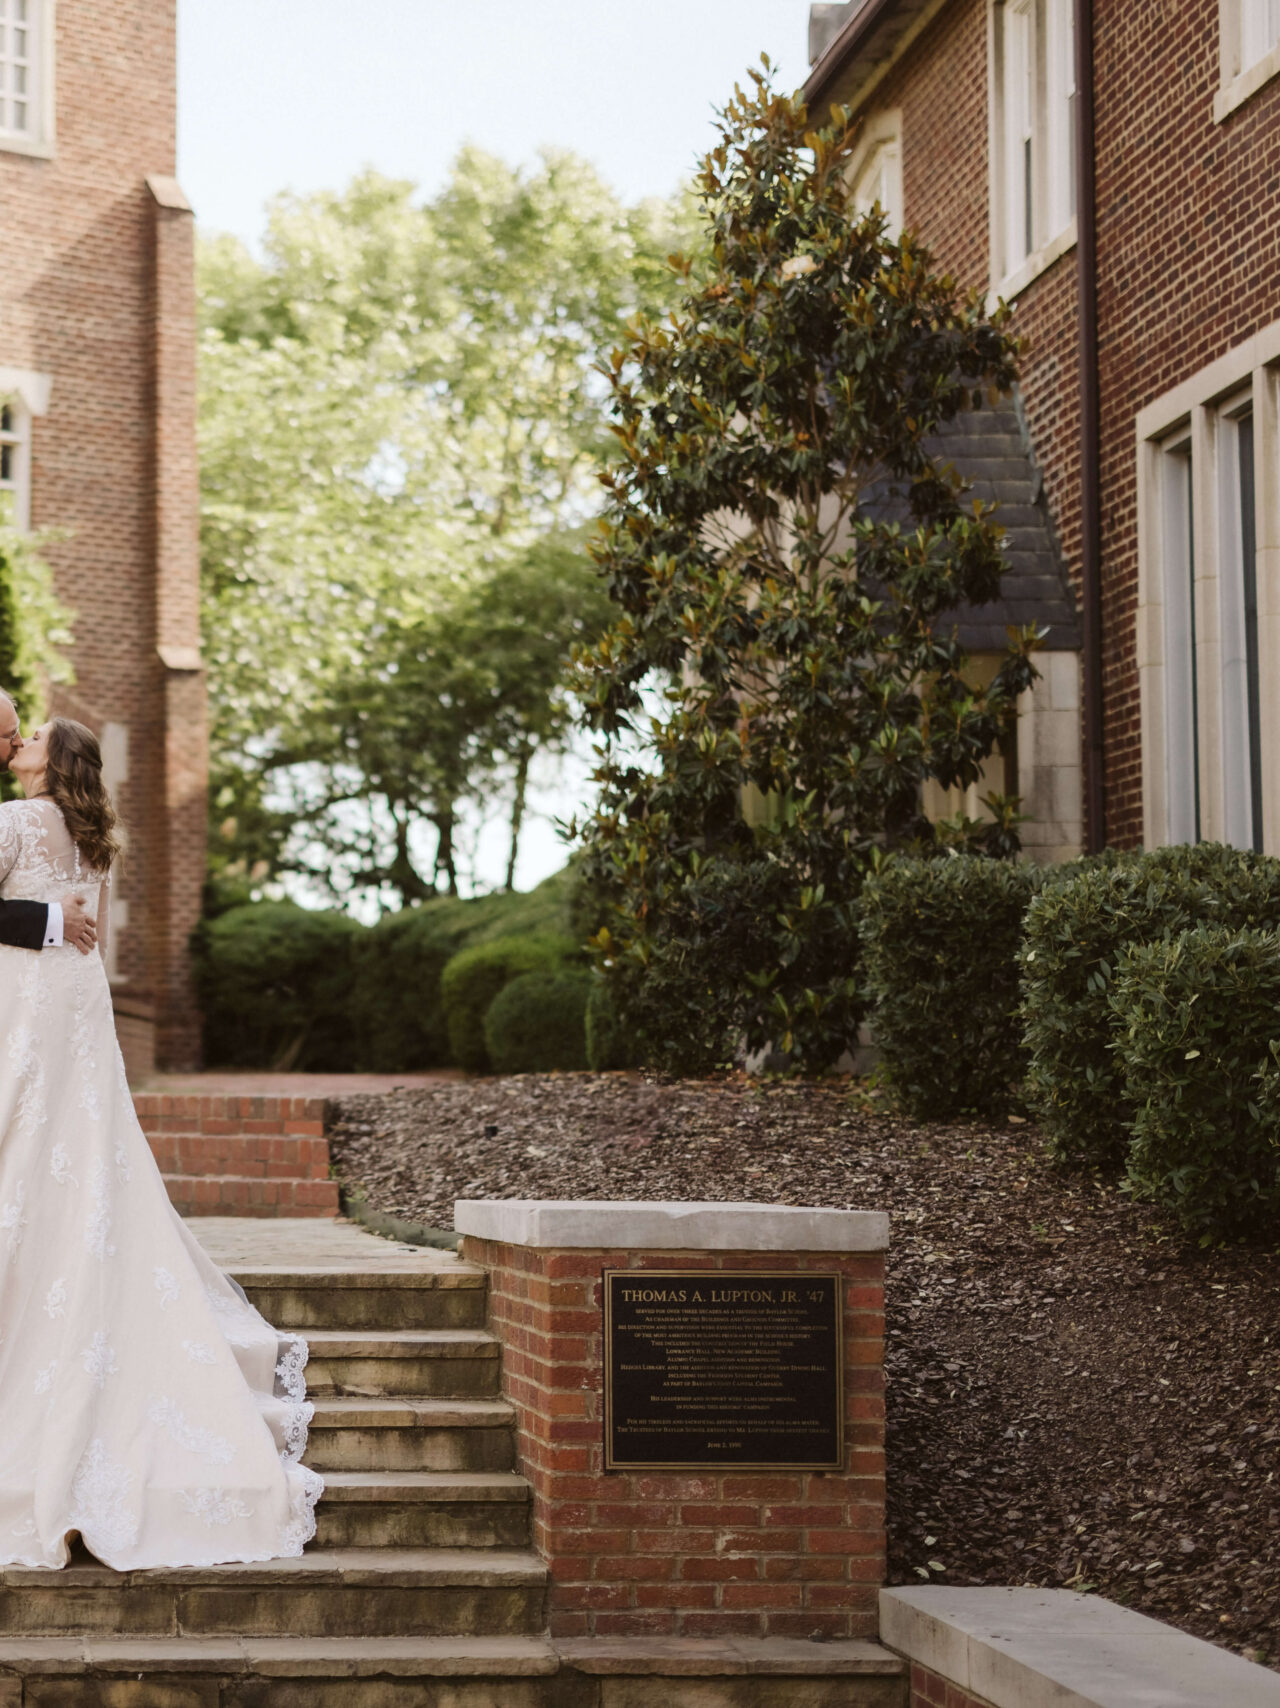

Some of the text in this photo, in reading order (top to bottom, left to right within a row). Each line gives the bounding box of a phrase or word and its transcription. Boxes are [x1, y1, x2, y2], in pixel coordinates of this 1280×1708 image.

[622, 1289, 687, 1302] THOMAS
[692, 1289, 706, 1302] A.
[712, 1289, 776, 1302] LUPTON,
[780, 1289, 801, 1302] JR.
